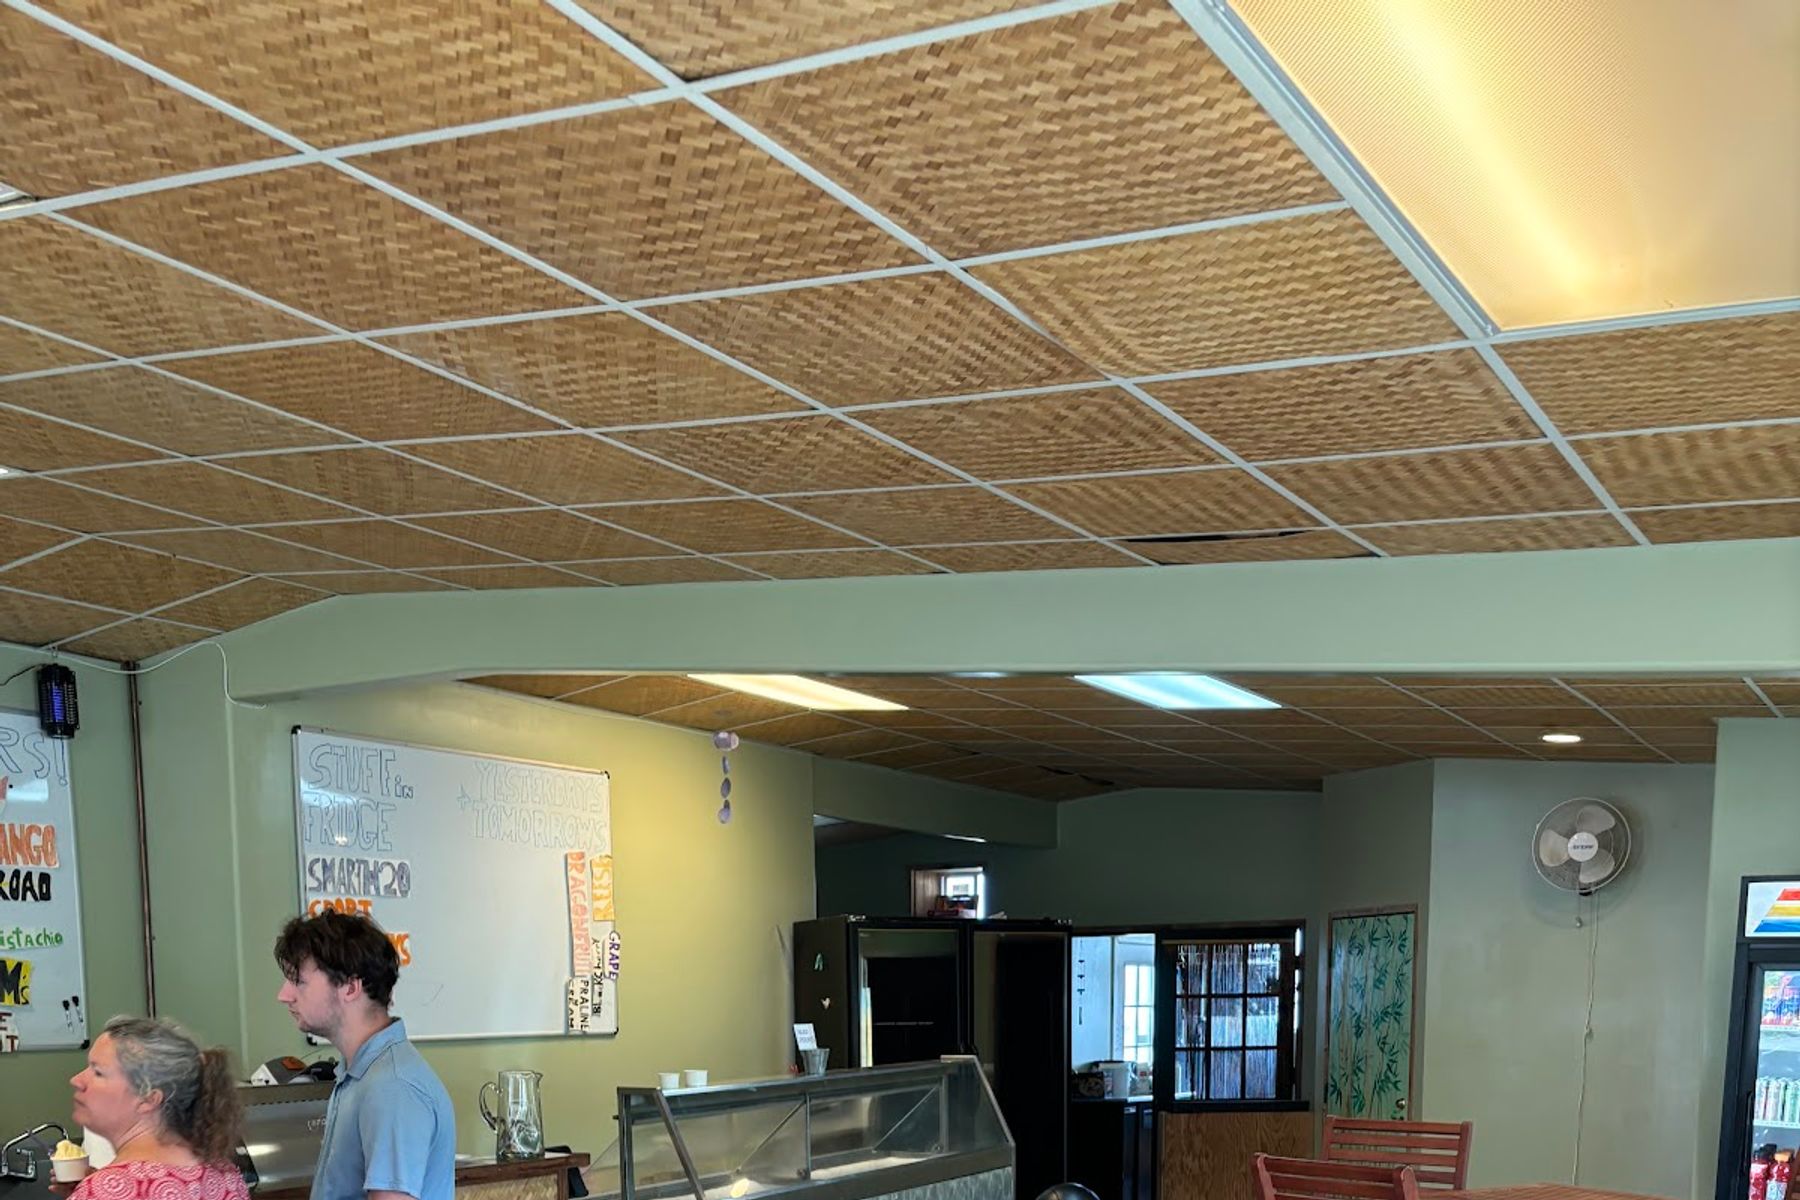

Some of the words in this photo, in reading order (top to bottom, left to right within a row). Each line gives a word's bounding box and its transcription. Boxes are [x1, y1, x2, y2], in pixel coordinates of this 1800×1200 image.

[308, 743, 396, 796] STUFF
[473, 761, 606, 813] YESTERDAYS
[303, 791, 397, 851] FRIDGE
[472, 802, 608, 849] TOMORROWS
[609, 930, 621, 981] GRAPE
